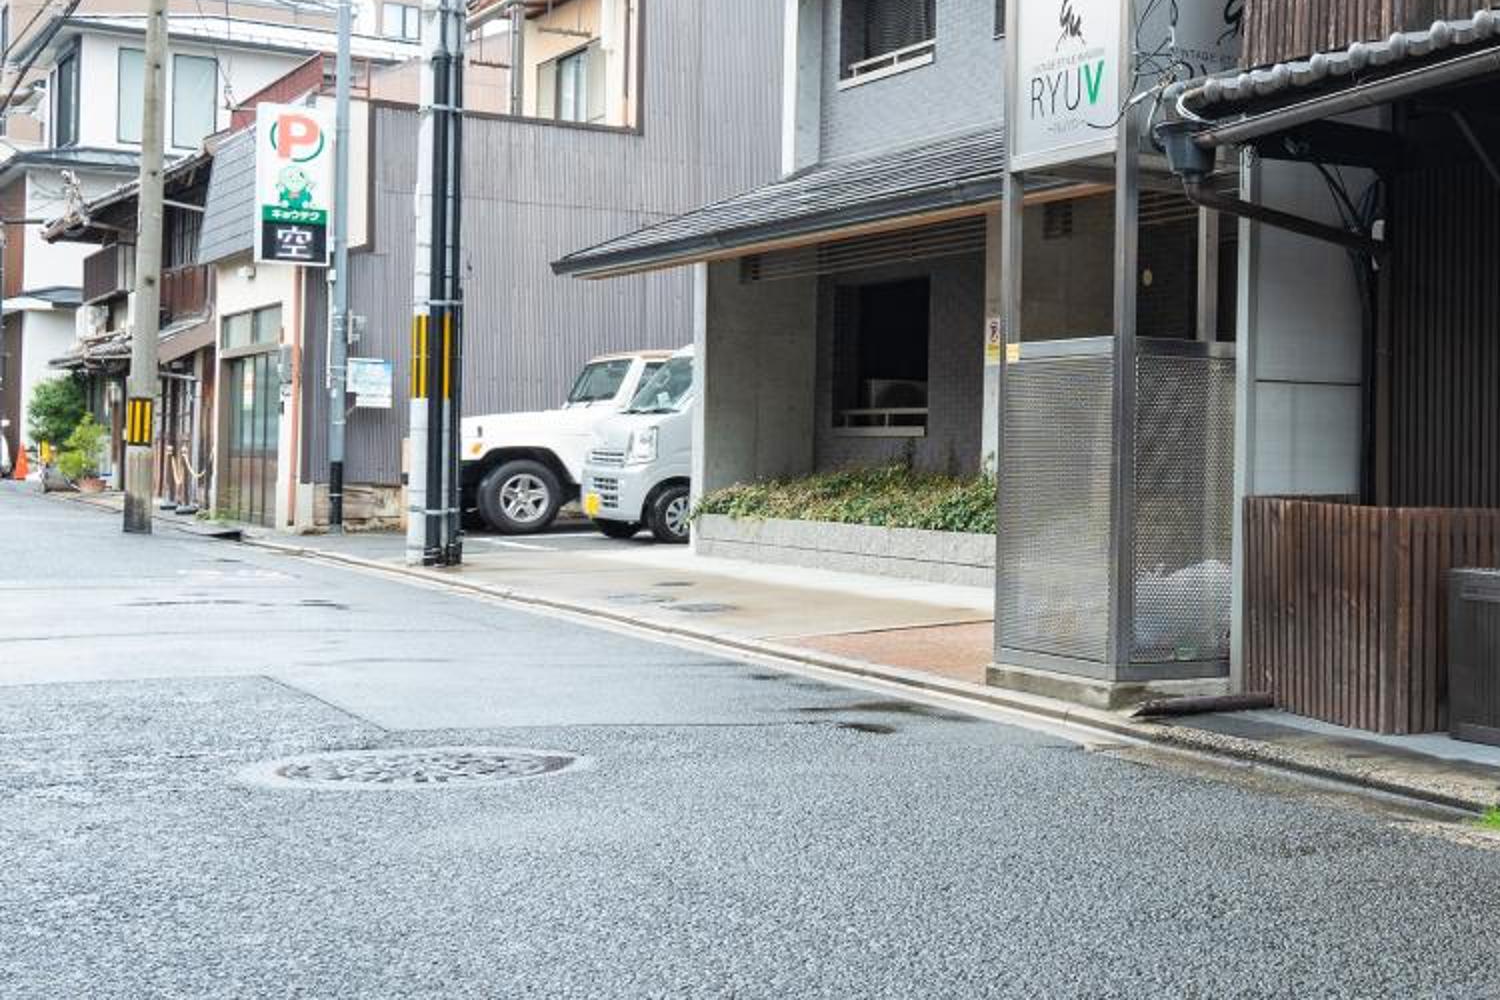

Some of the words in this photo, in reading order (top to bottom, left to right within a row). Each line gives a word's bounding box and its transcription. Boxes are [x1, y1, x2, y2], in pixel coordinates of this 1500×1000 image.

[1031, 59, 1105, 120] RYUV
[277, 114, 320, 159] P
[275, 225, 313, 259] 空
